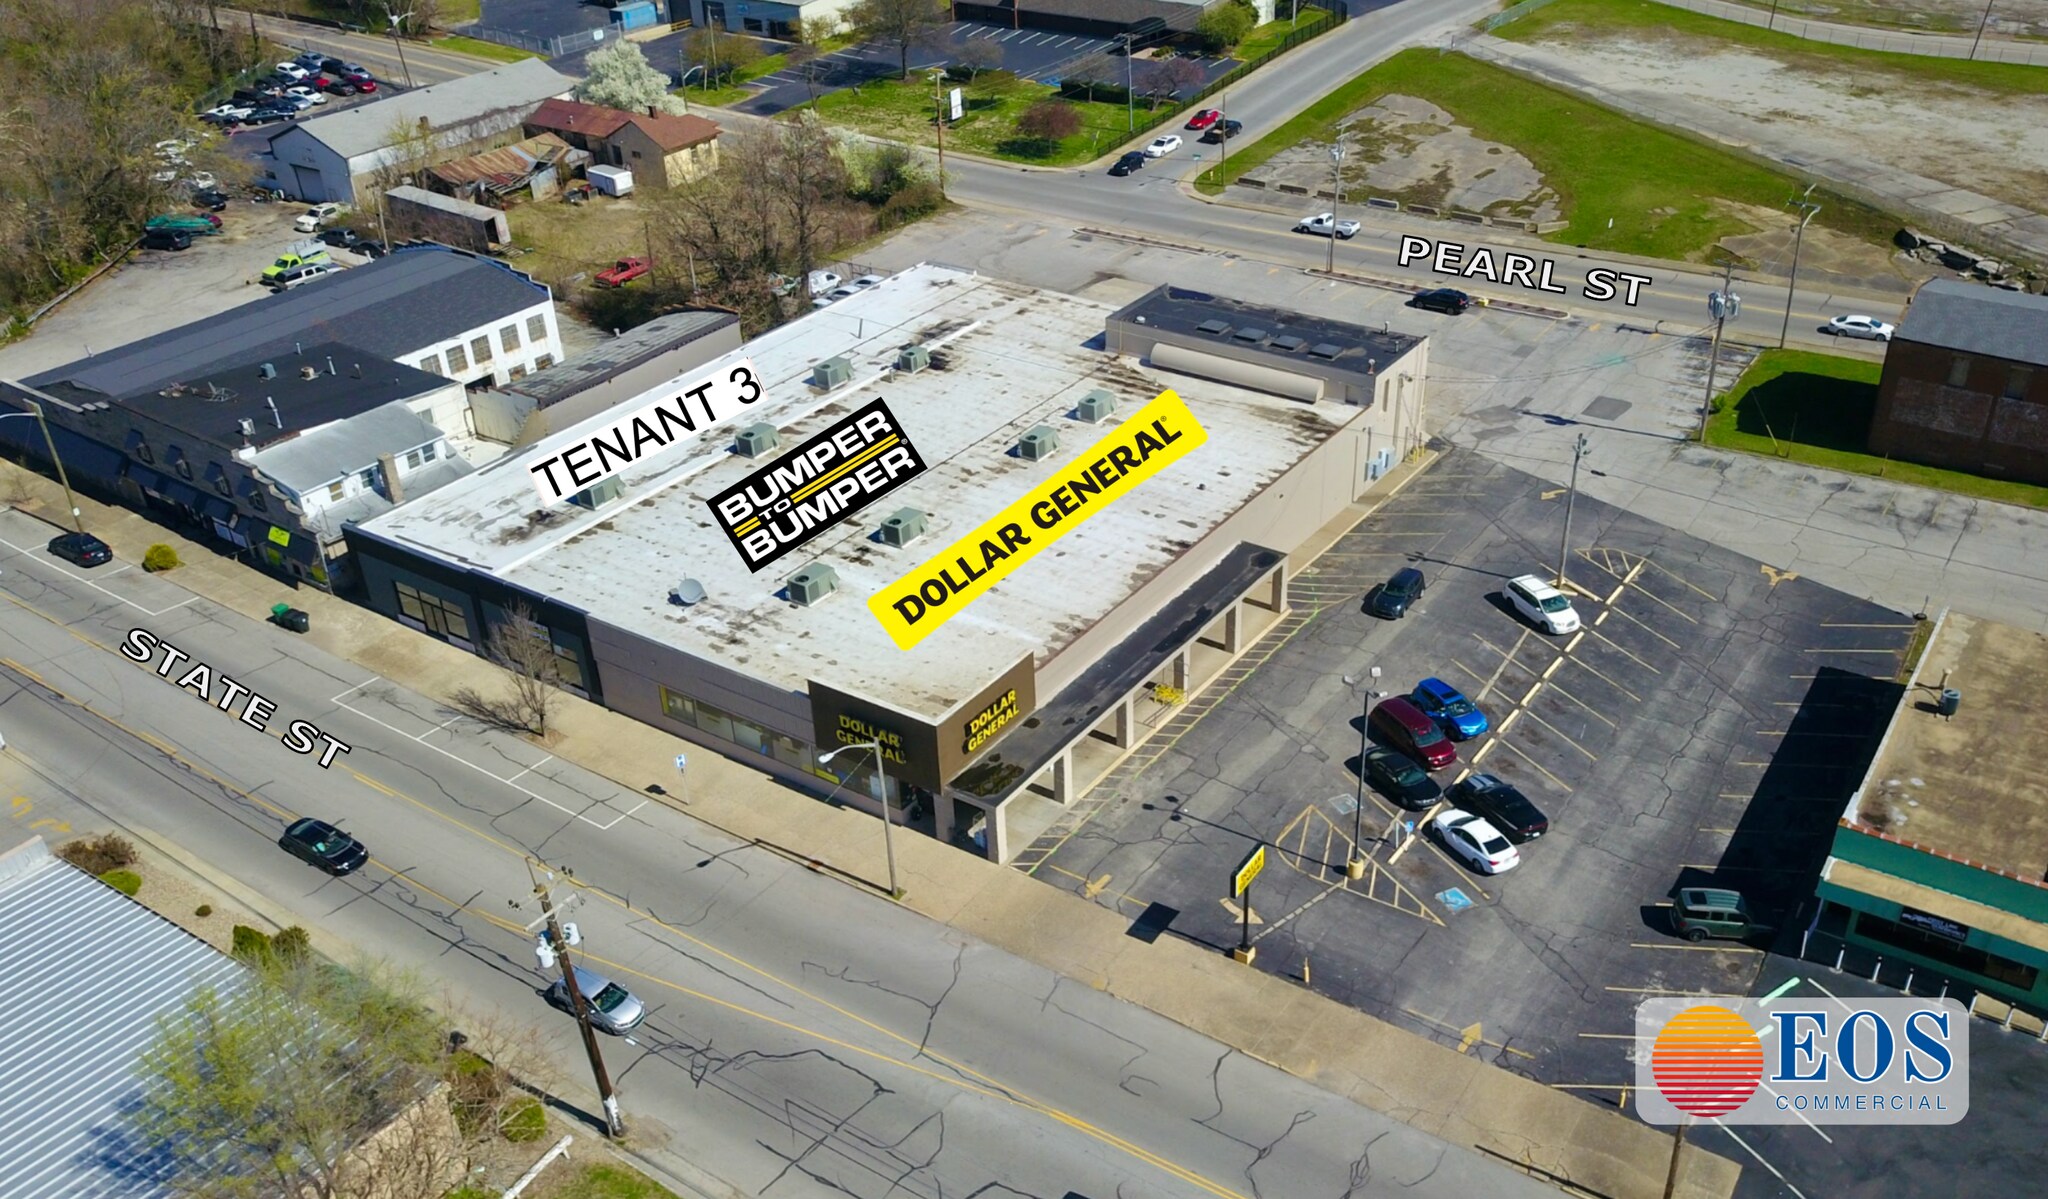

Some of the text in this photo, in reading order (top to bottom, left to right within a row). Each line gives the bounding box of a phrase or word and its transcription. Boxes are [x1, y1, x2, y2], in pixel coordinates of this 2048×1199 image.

[838, 714, 900, 747] DOLLAR
[967, 704, 1020, 752] GENERAL
[969, 689, 1016, 733] DOLLAR
